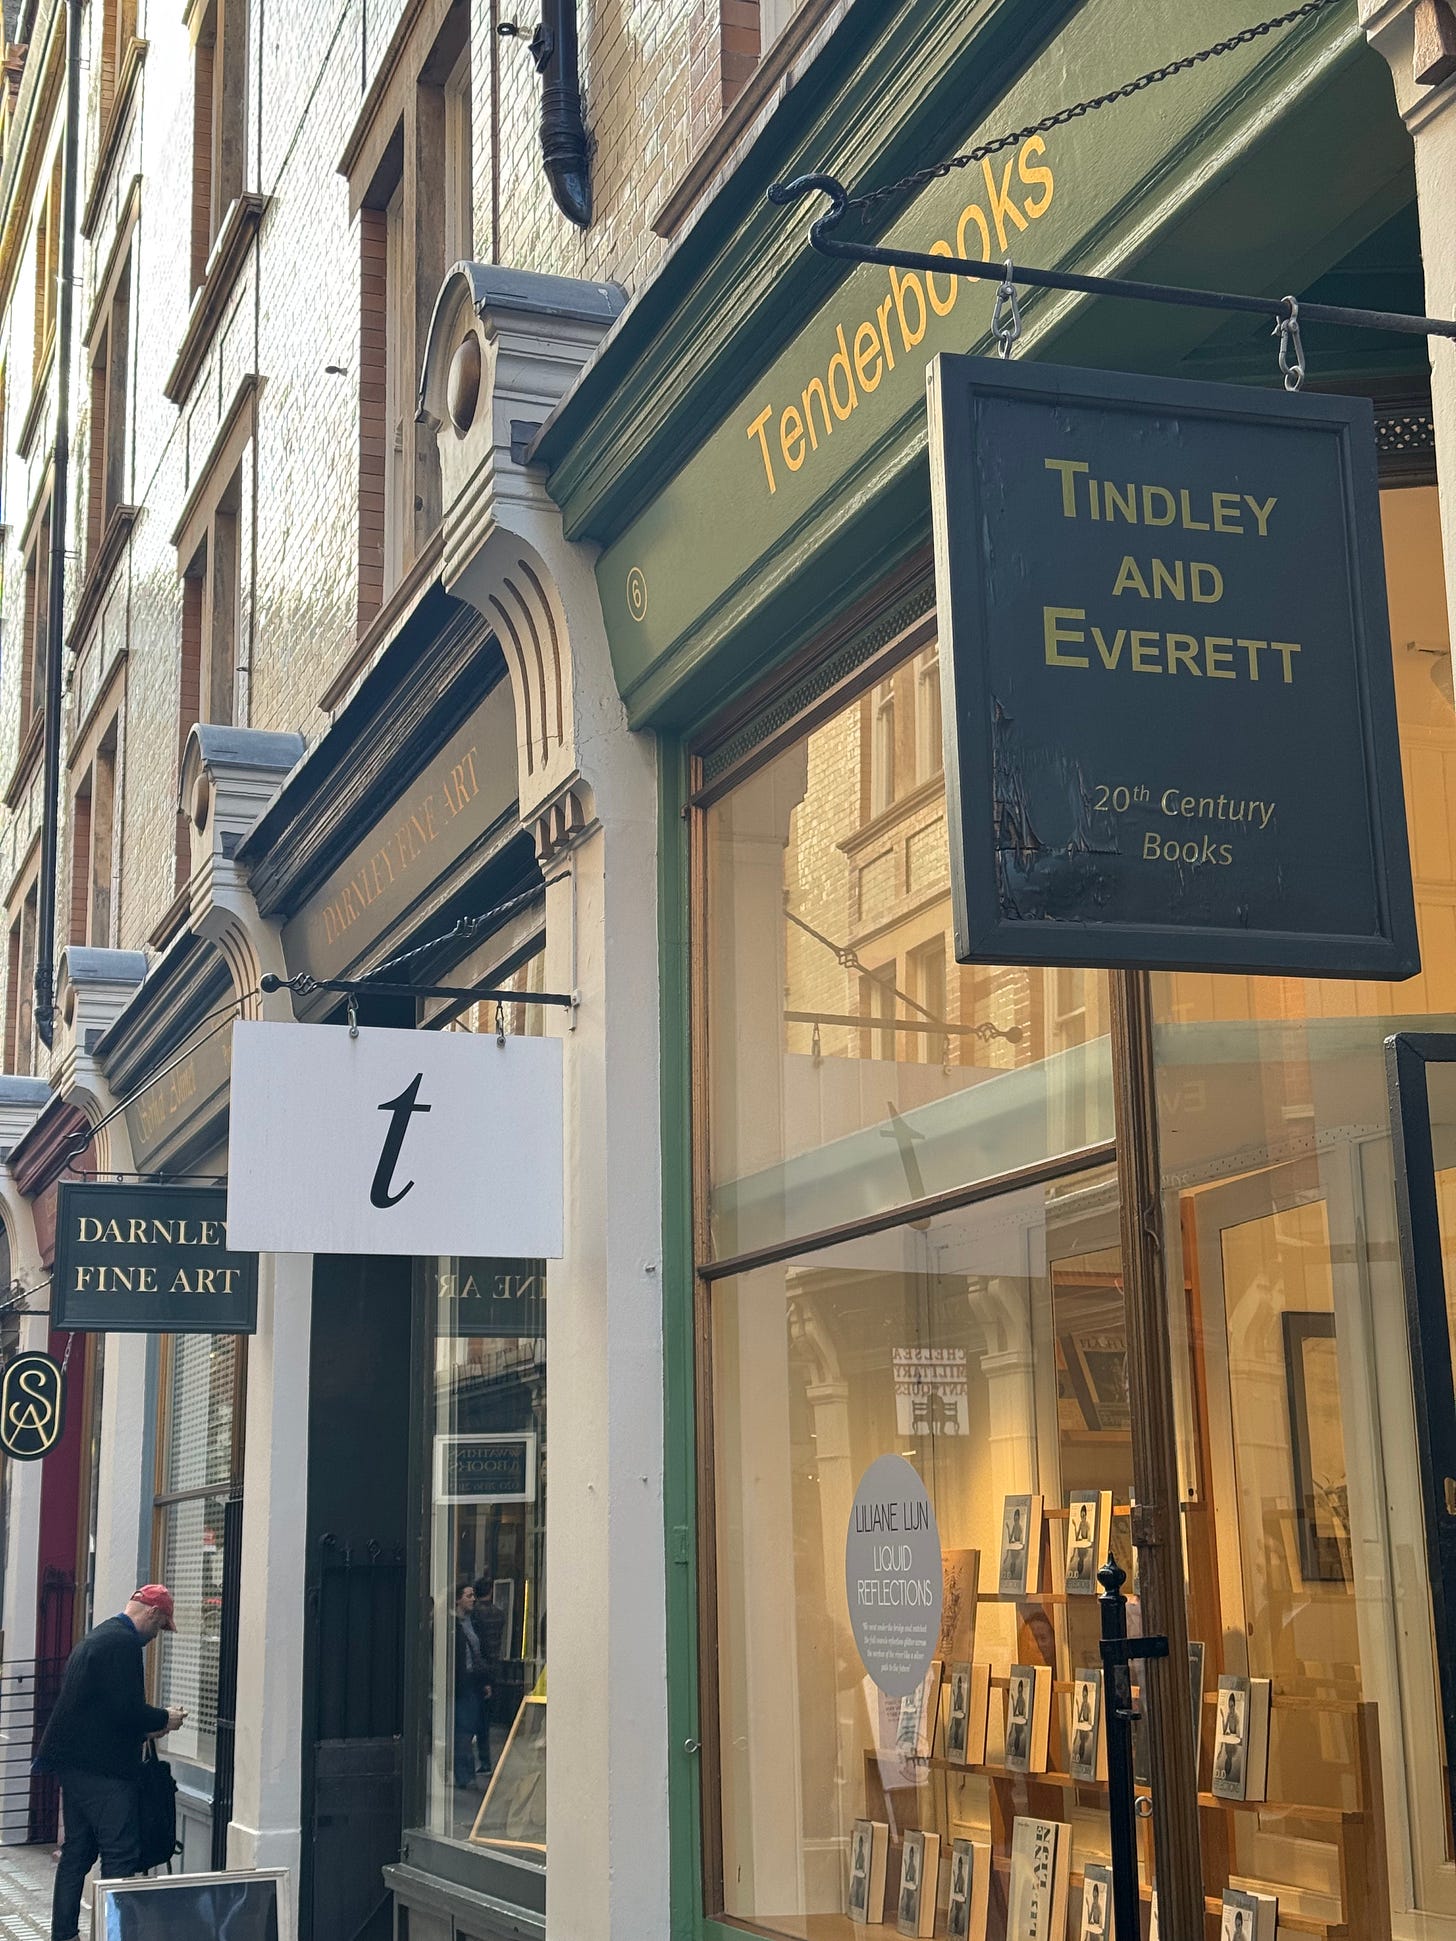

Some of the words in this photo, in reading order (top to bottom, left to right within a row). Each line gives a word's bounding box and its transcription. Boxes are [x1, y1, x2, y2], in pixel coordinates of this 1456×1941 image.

[746, 131, 1056, 495] Tenderbooks
[1111, 555, 1224, 604] AND
[442, 747, 480, 817] ART
[1093, 784, 1150, 814] 20th
[1160, 787, 1276, 829] Century
[1142, 832, 1234, 867] Books
[369, 1072, 431, 1209] t
[75, 1266, 158, 1294] FINE
[169, 1268, 240, 1295] ART
[855, 1502, 898, 1533] LILIANE
[873, 1545, 912, 1572] LIQUID
[857, 1580, 933, 1607] REFLECTIONS
